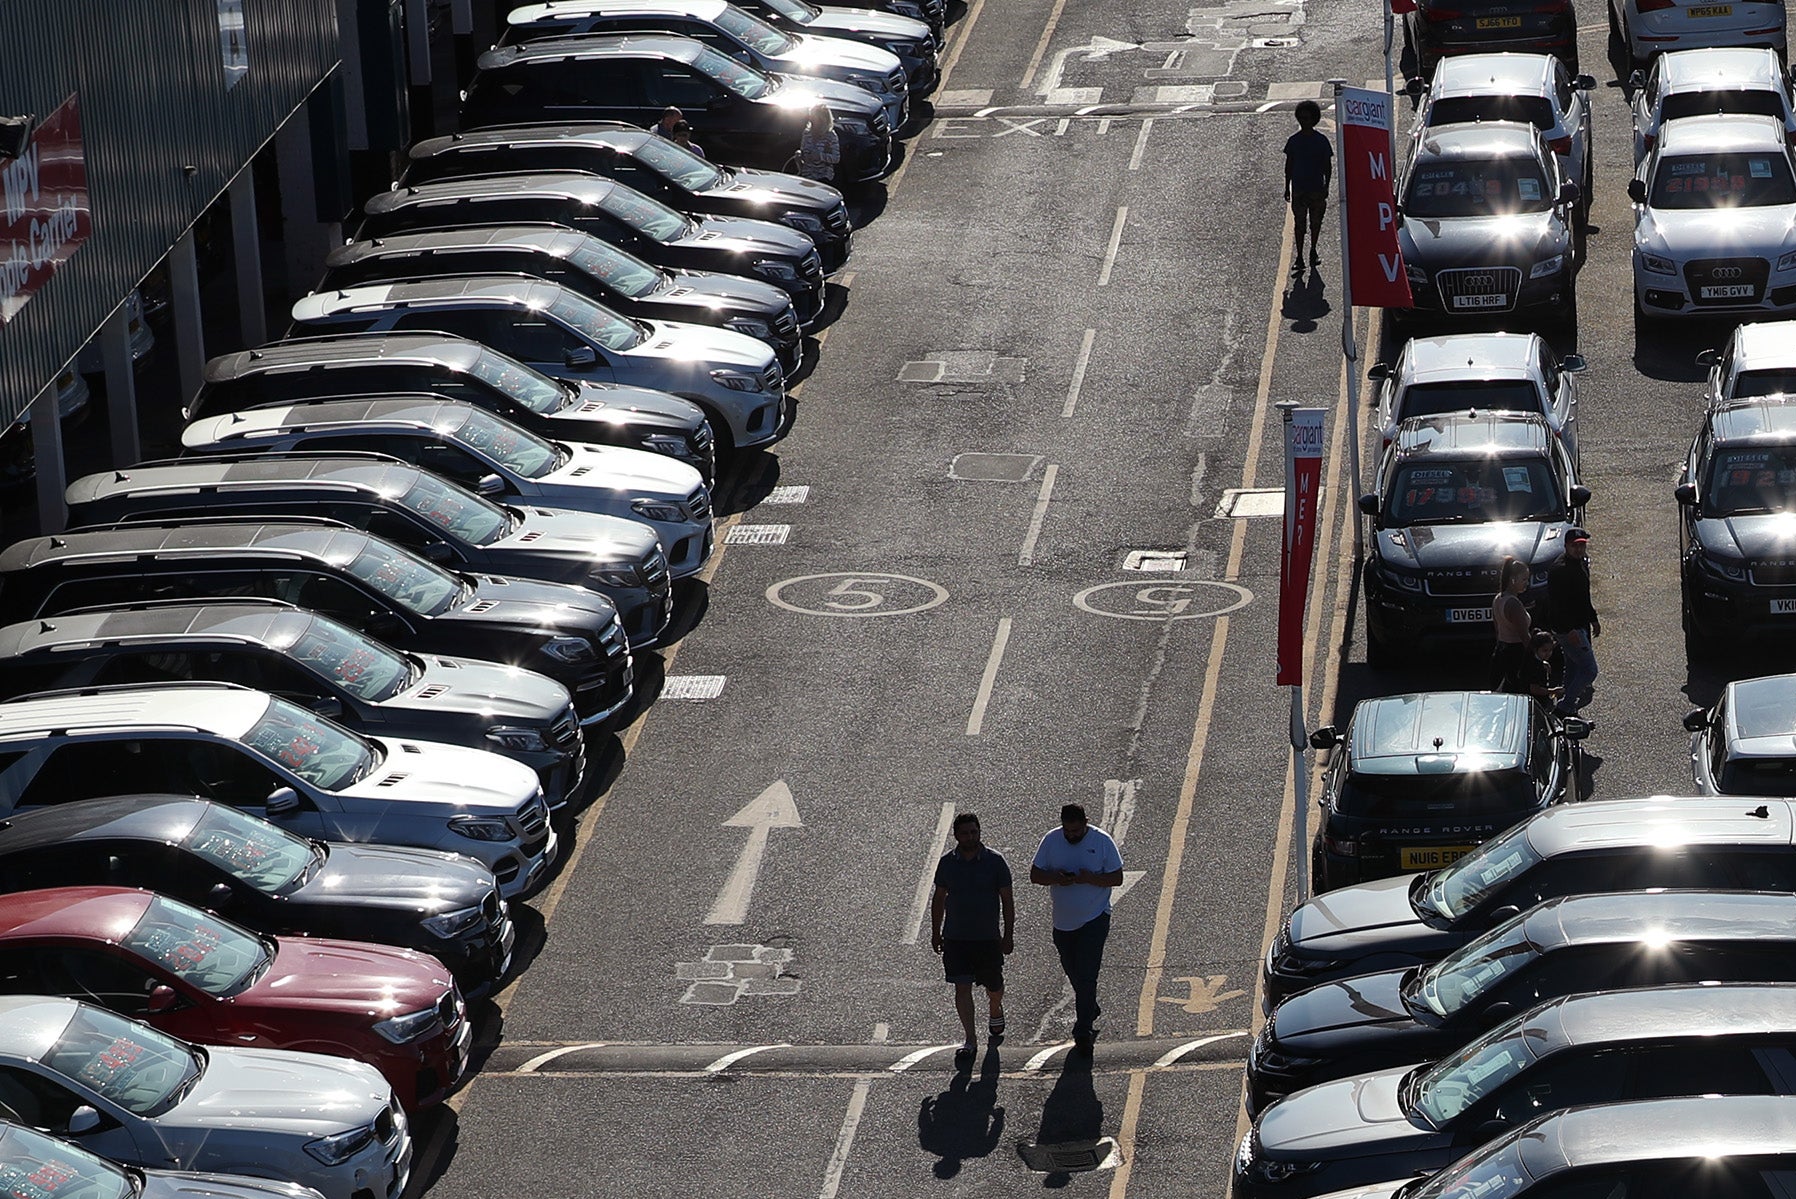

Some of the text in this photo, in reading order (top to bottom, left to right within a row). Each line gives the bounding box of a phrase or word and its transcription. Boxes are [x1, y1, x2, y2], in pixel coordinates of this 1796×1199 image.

[1346, 98, 1386, 122] cargiant
[3, 141, 39, 227] MPV
[30, 193, 79, 271] Carrier
[1459, 296, 1480, 306] LT16
[824, 579, 890, 611] 5
[1452, 608, 1482, 620] OV66
[1442, 824, 1493, 833] ROVER
[1409, 852, 1439, 864] NU16
